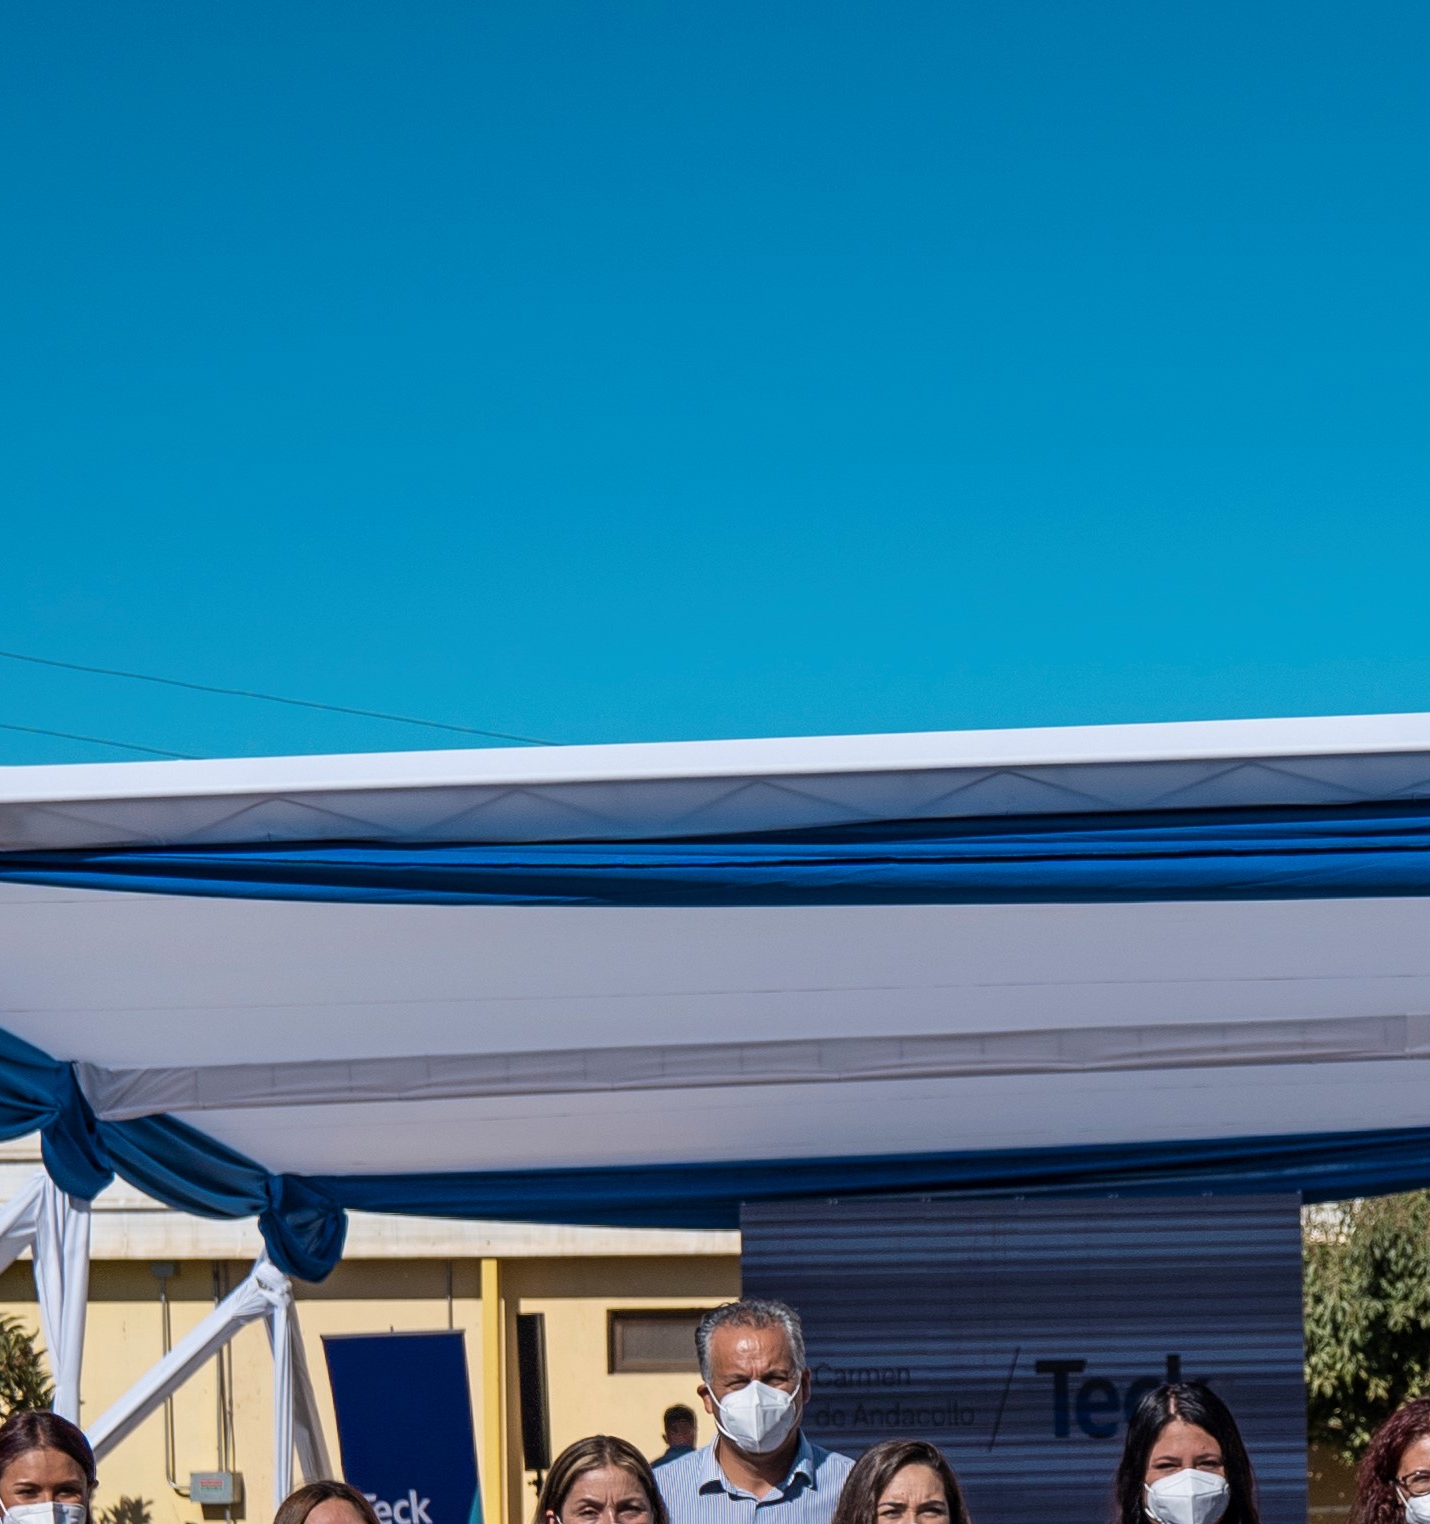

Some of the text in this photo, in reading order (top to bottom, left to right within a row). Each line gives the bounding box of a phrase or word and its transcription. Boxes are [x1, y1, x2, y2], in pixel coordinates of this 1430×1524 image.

[814, 1363, 911, 1387] Carmen
[814, 1400, 976, 1427] de Andacollo
